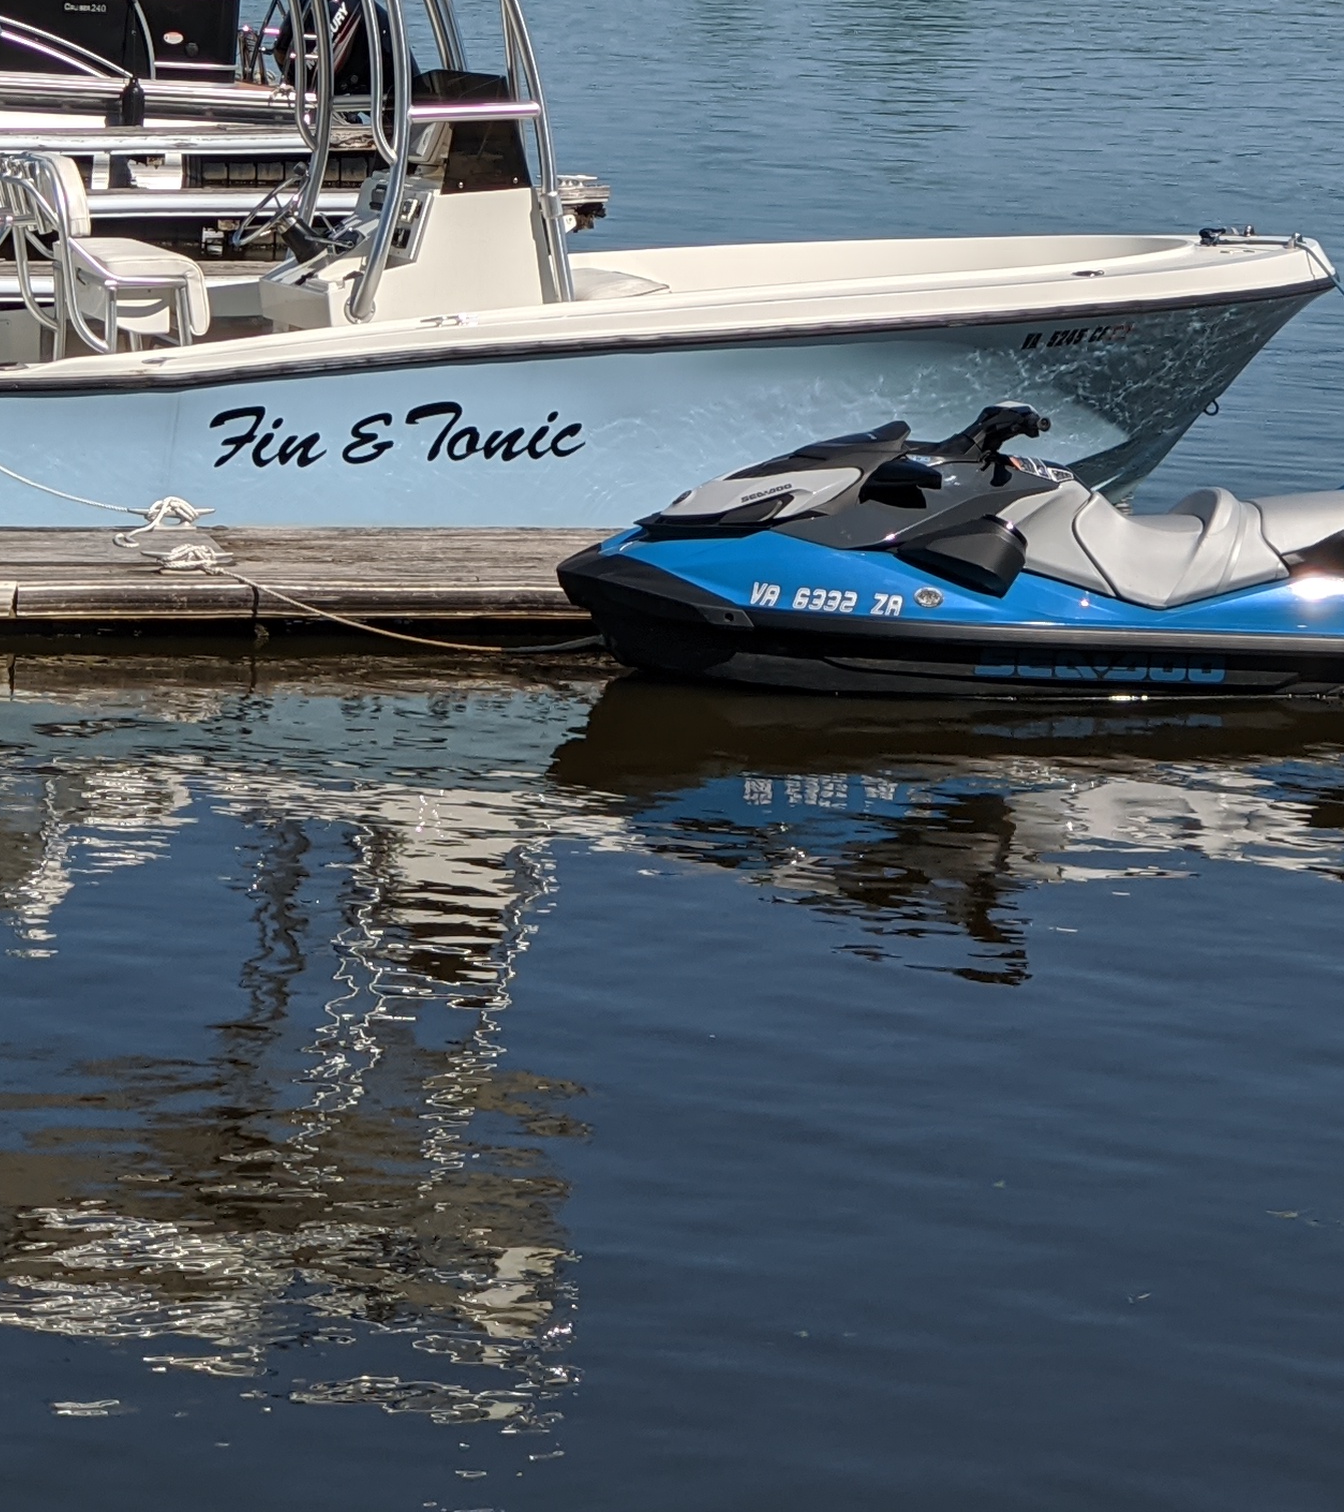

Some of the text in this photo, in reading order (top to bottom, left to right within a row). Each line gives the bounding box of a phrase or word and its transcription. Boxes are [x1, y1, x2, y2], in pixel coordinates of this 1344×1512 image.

[208, 400, 586, 468] Fin & Tonic
[749, 581, 904, 616] VA 6332 ZA
